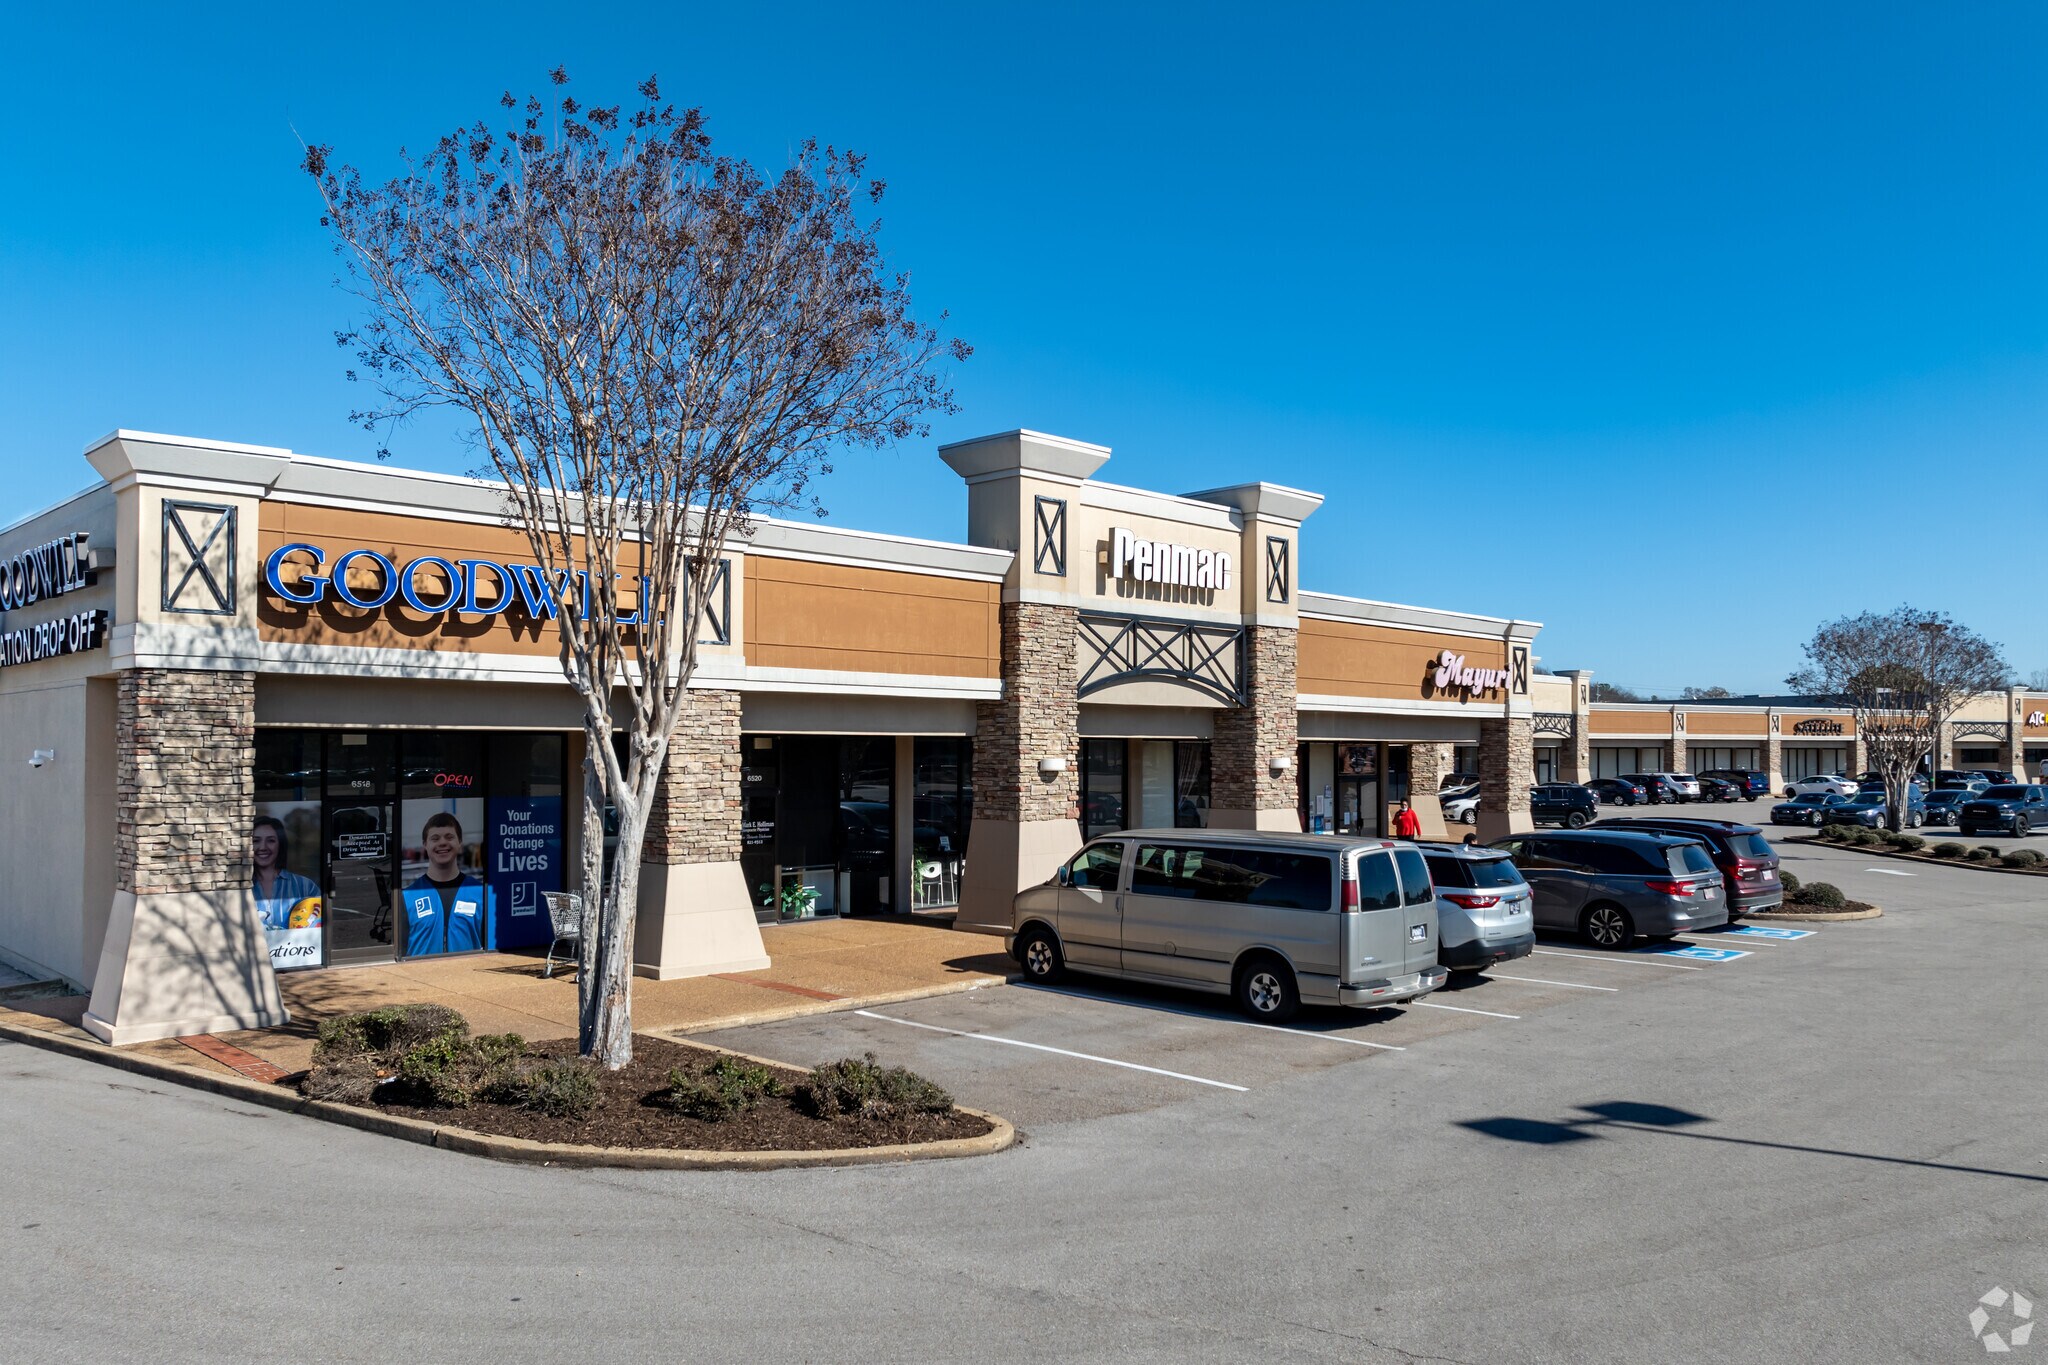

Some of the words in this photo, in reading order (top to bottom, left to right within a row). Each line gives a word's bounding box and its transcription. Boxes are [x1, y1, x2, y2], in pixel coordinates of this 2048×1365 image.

[1112, 526, 1232, 590] Penmac
[33, 618, 66, 660] DROP
[69, 609, 97, 653] OFF
[1434, 649, 1515, 696] Mayuri
[2028, 710, 2045, 726] ATC
[351, 780, 371, 788] 6518
[434, 773, 473, 787] OPEN
[507, 810, 531, 821] Your
[500, 823, 554, 836] Donations
[503, 838, 544, 851] Change
[498, 852, 548, 873] Lives
